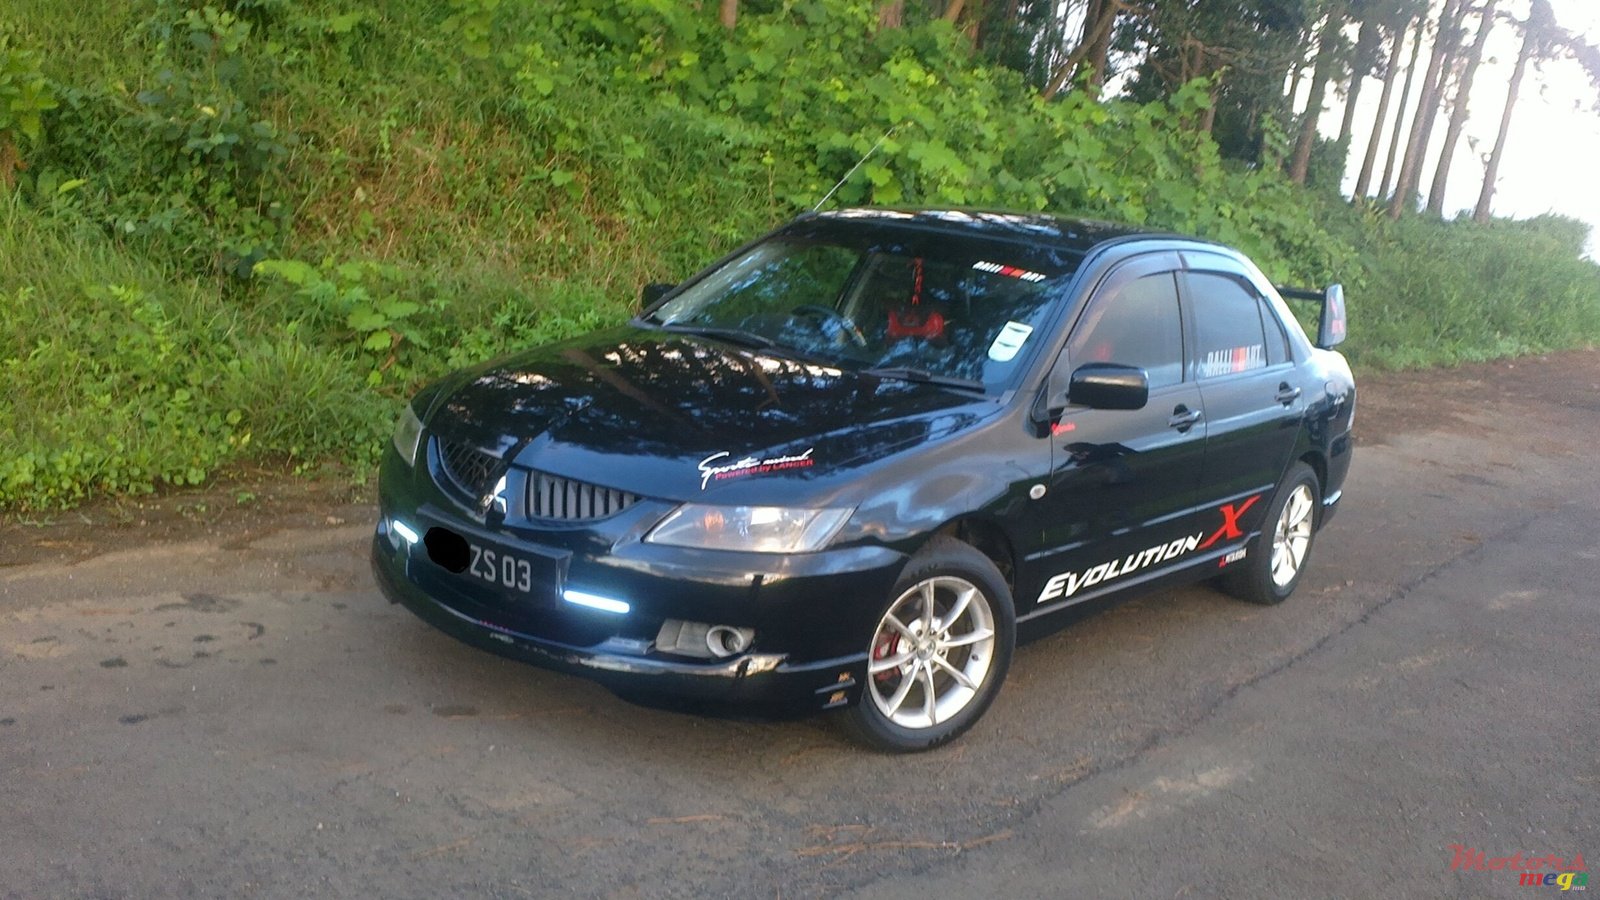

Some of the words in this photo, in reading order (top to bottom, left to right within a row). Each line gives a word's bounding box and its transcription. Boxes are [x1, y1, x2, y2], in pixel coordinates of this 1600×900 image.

[715, 466, 758, 480] Powered
[470, 544, 496, 582] ZS
[502, 555, 531, 593] 03
[1037, 532, 1203, 603] EVOLUTION
[1199, 494, 1261, 549] X
